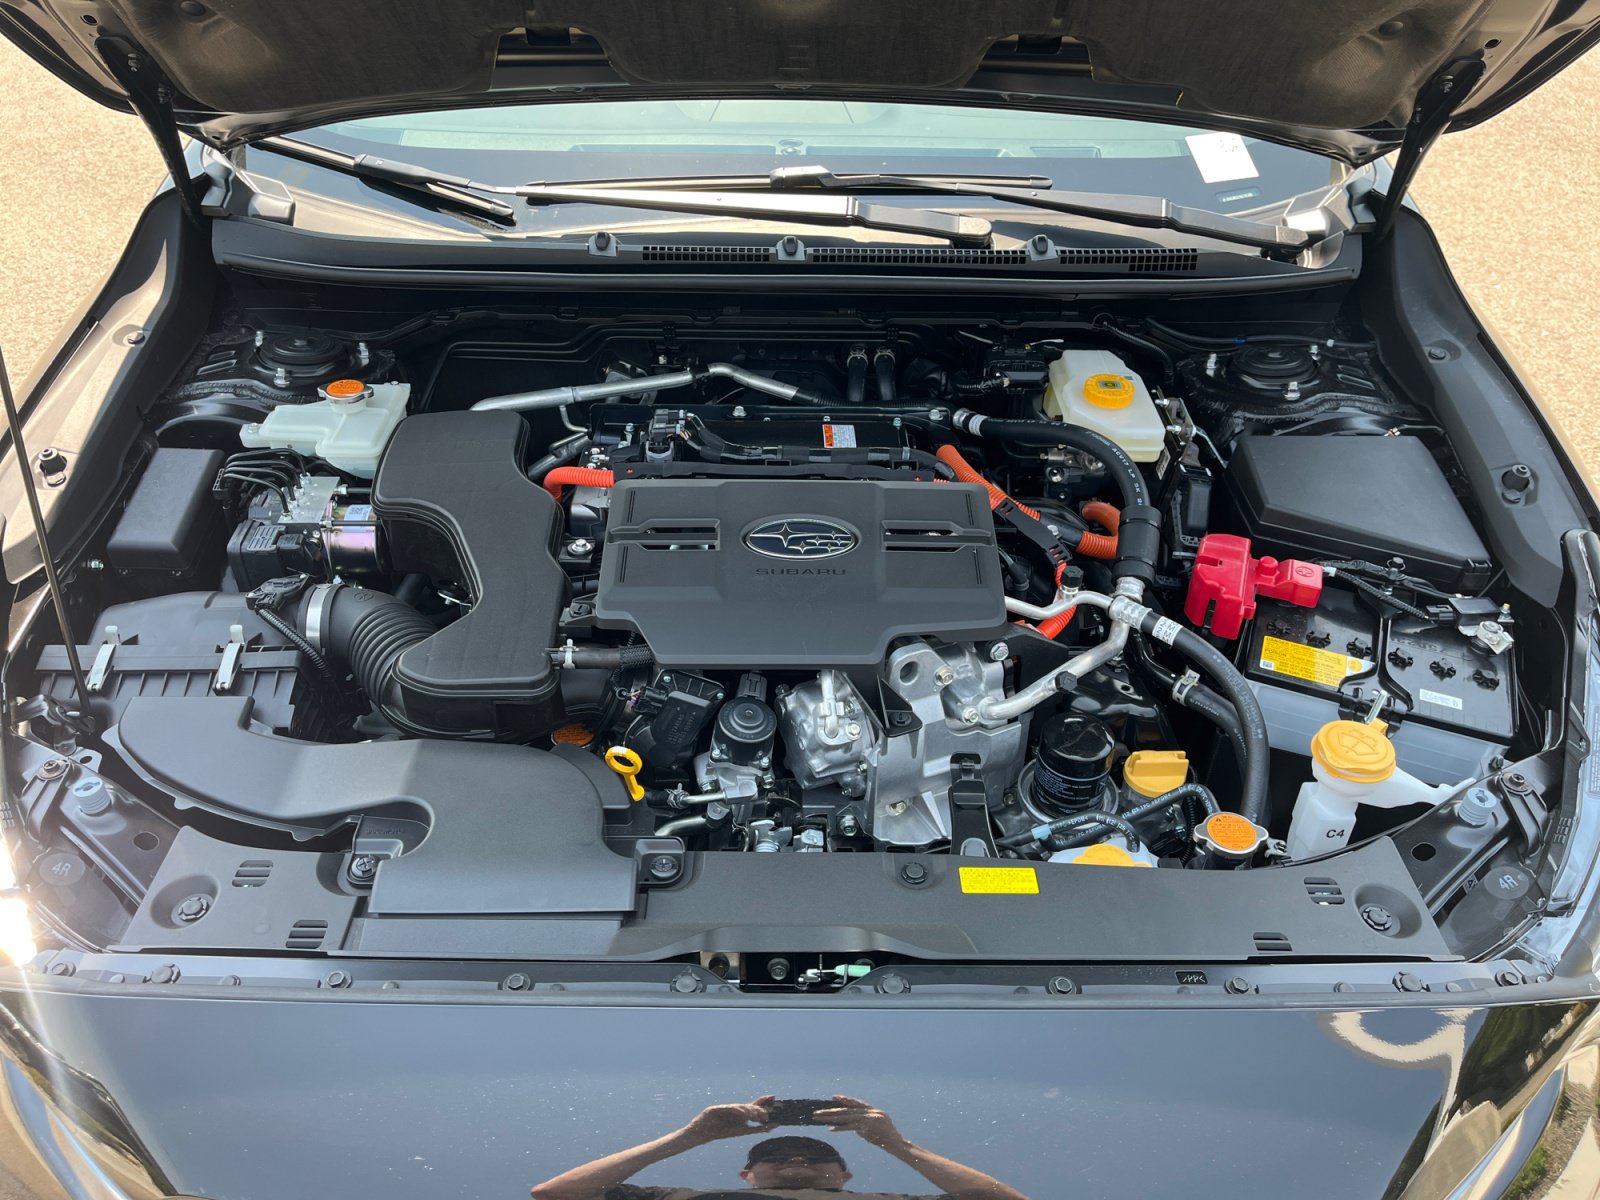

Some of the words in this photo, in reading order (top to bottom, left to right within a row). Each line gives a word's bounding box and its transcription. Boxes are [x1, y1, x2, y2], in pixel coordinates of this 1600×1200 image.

[755, 568, 846, 576] SUBARU
[1326, 828, 1345, 839] C4
[51, 862, 71, 876] 4R
[1498, 874, 1518, 888] 4R
